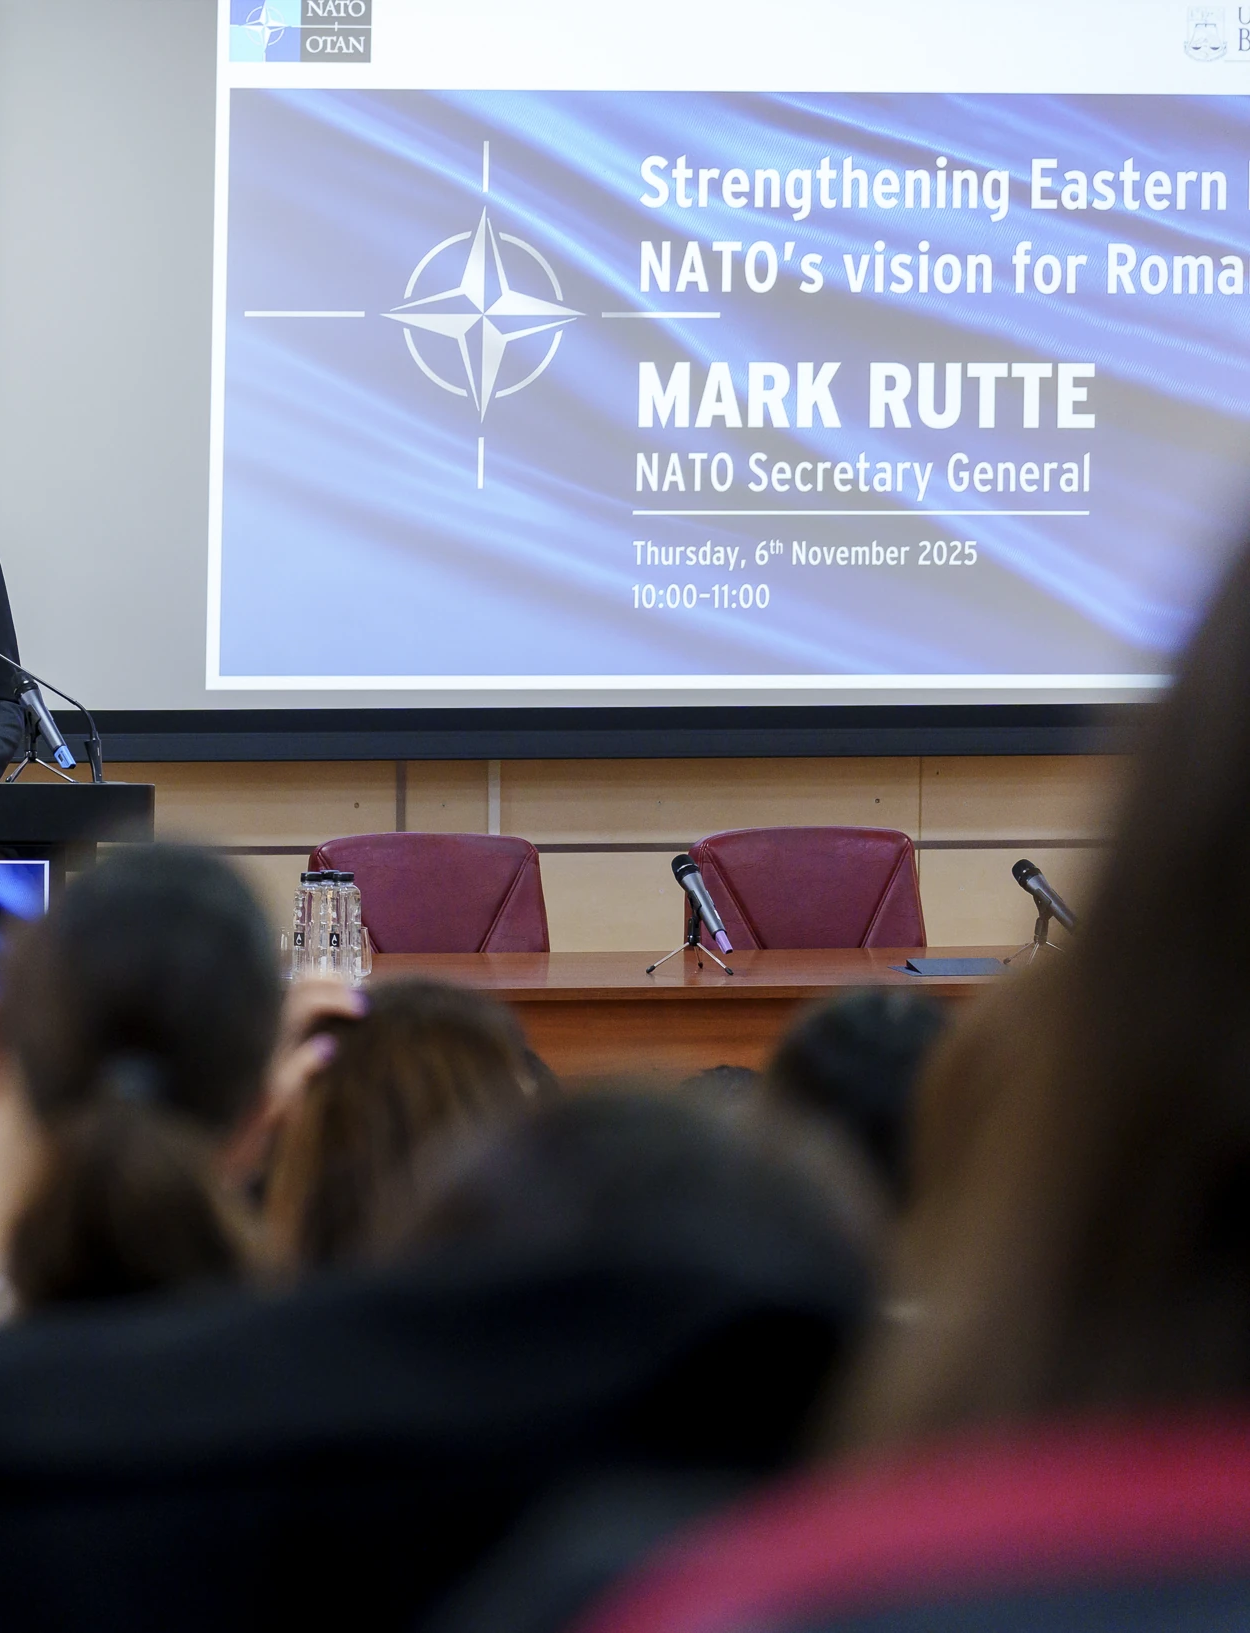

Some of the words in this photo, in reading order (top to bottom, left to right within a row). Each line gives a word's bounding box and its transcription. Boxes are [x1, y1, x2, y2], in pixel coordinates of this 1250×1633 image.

[306, 0, 366, 17] NATO
[305, 36, 365, 53] OTAN
[639, 154, 1010, 222] Strengthening
[1031, 157, 1227, 211] Eastern
[843, 240, 993, 294] vision
[1012, 240, 1088, 295] for
[637, 361, 842, 429] MARK
[868, 362, 1096, 430] RUTTE
[635, 452, 735, 493] NATO
[747, 451, 934, 502] Secretary
[947, 452, 1091, 493] General
[632, 540, 747, 571] Thursday,
[754, 539, 784, 566] 6th
[791, 540, 910, 566] November
[917, 540, 978, 566] 2025
